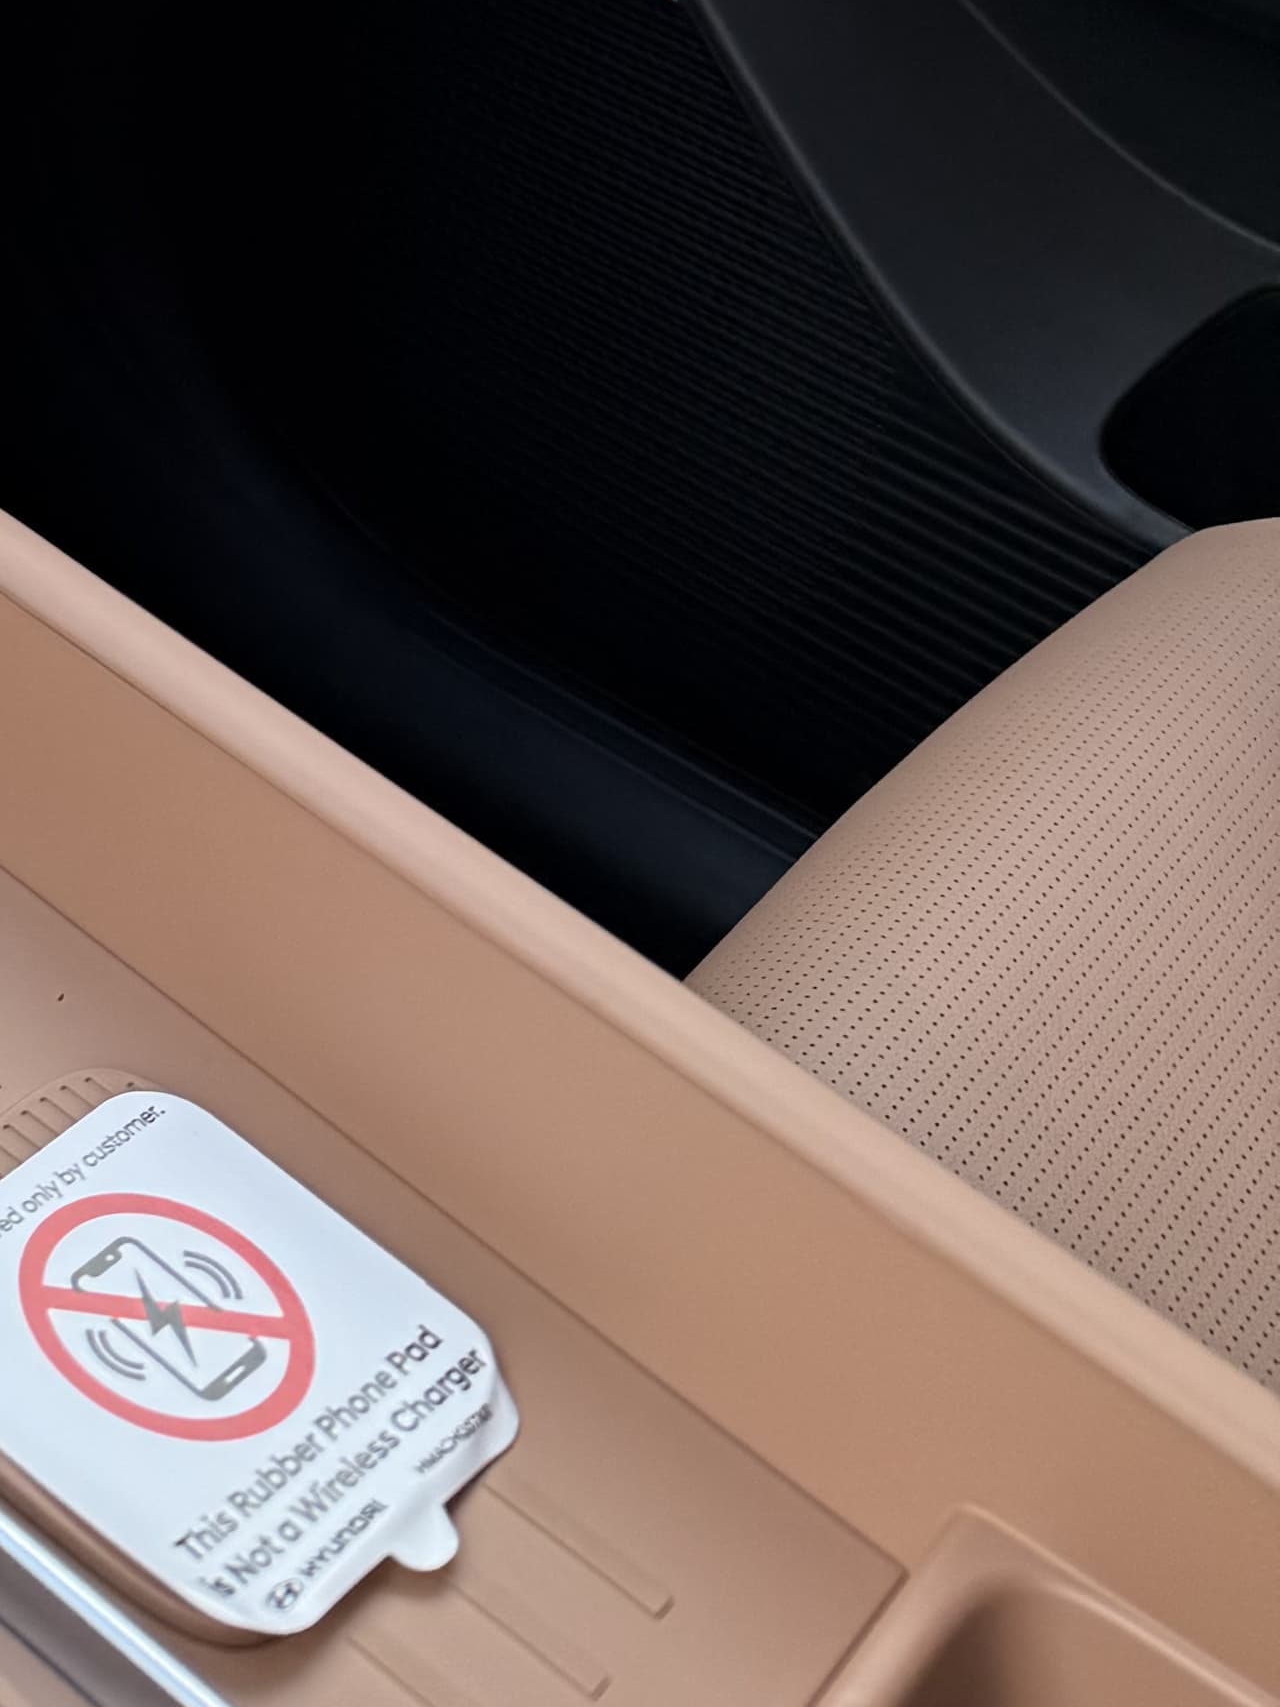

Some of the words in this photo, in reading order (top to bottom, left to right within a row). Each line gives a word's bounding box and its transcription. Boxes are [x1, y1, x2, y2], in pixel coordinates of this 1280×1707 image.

[21, 1180, 64, 1215] only
[53, 1163, 87, 1188] by
[82, 1105, 167, 1169] customer.
[391, 1349, 488, 1433] Charger
[174, 1515, 239, 1561] This
[227, 1433, 326, 1518] Rubber
[314, 1371, 398, 1441] Phone
[385, 1324, 444, 1377] Pad
[288, 1430, 401, 1525] Wireless
[219, 1534, 286, 1585] Not
[277, 1518, 305, 1543] a
[299, 1498, 389, 1577] HYUNDAI
[200, 1575, 237, 1598] is
